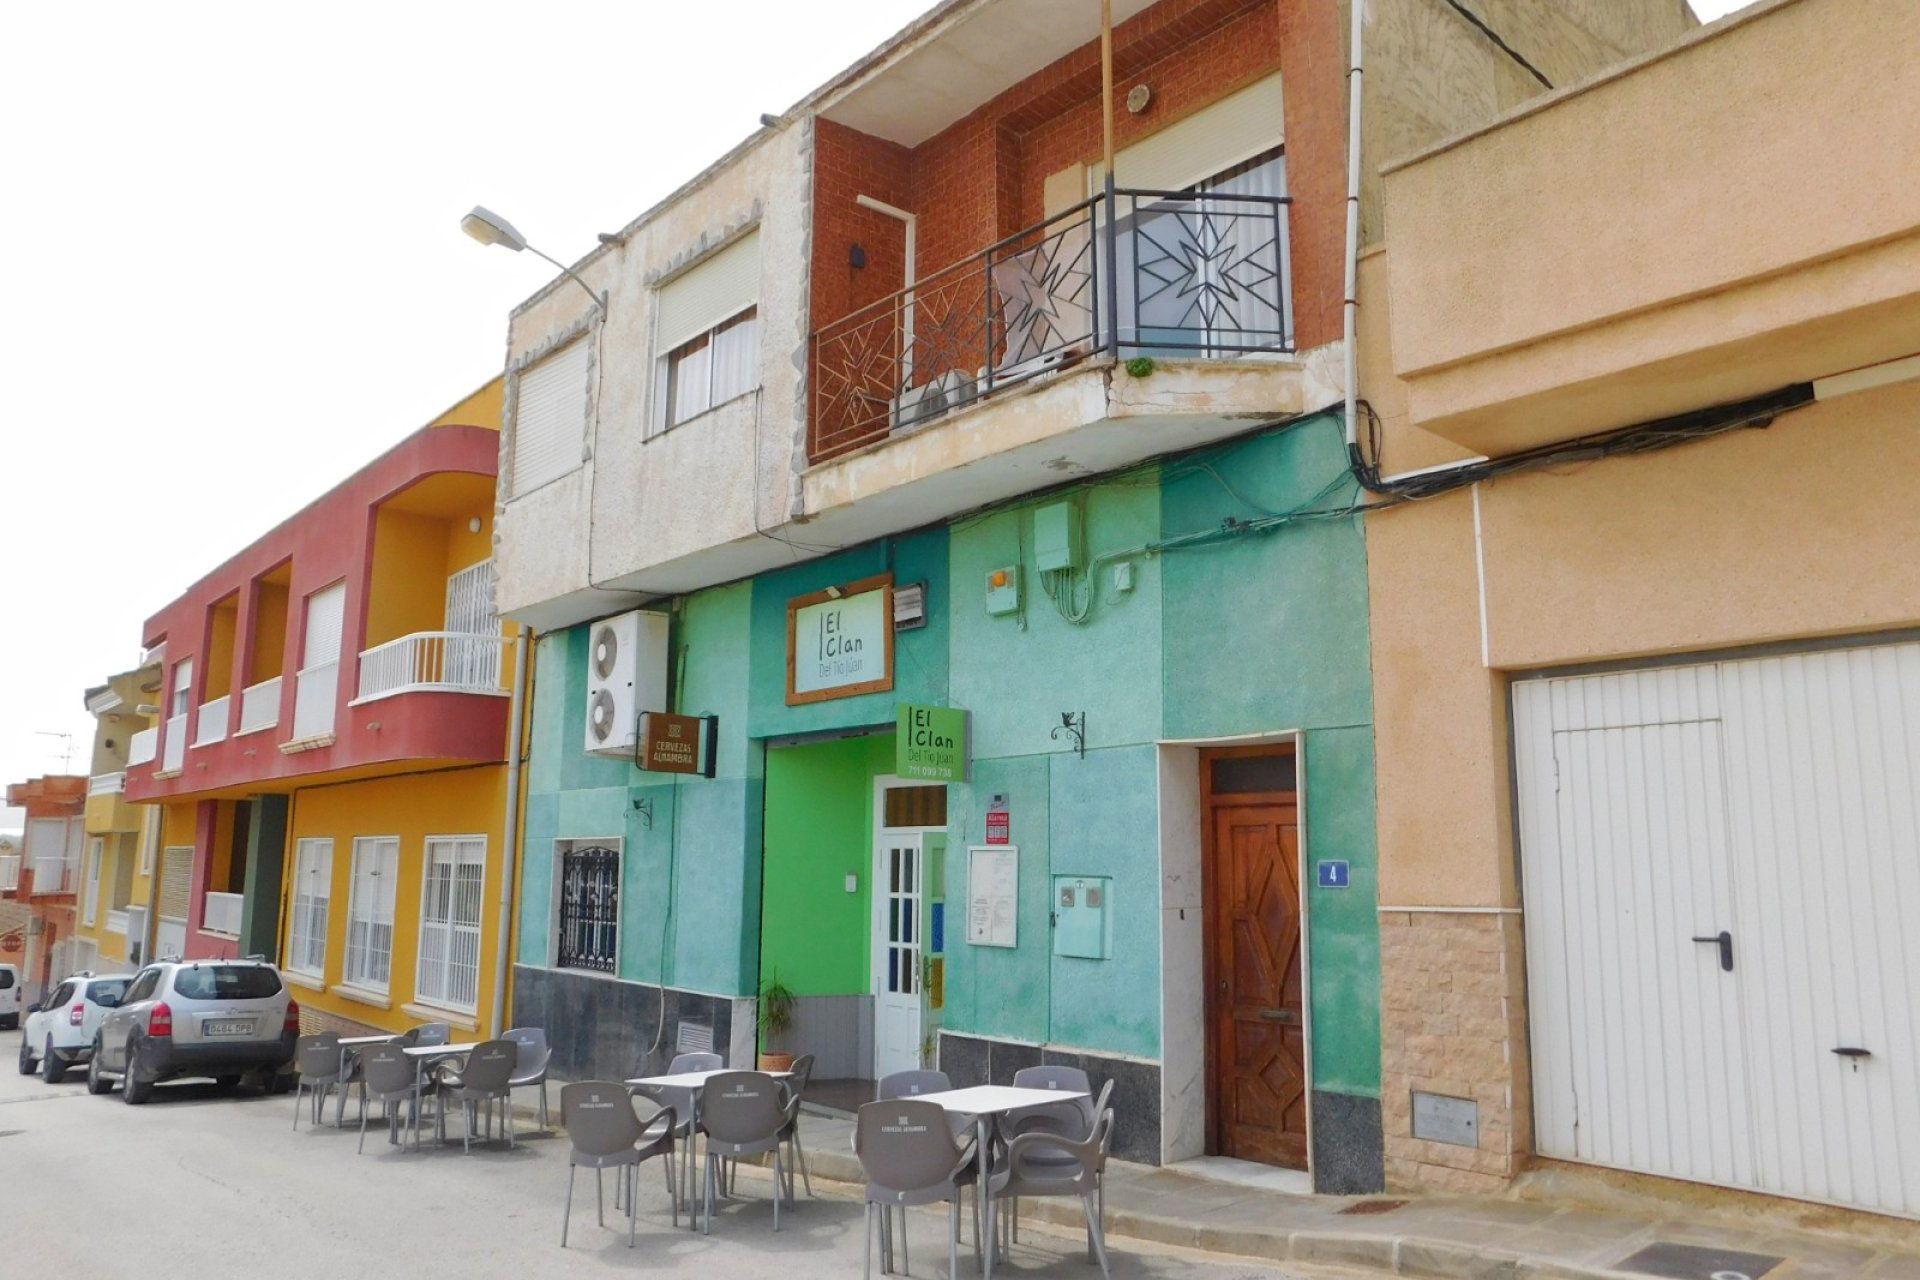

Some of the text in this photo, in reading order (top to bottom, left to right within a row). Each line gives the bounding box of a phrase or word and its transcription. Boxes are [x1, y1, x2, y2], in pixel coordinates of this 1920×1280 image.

[826, 611, 841, 634] El
[826, 634, 863, 658] Clan
[819, 661, 831, 678] Del
[916, 709, 931, 727] El
[656, 741, 692, 754] CERVEZAS
[915, 729, 954, 749] Clan
[653, 752, 693, 764] ALHAMBRA
[908, 748, 921, 762] Del
[1329, 865, 1337, 883] 4
